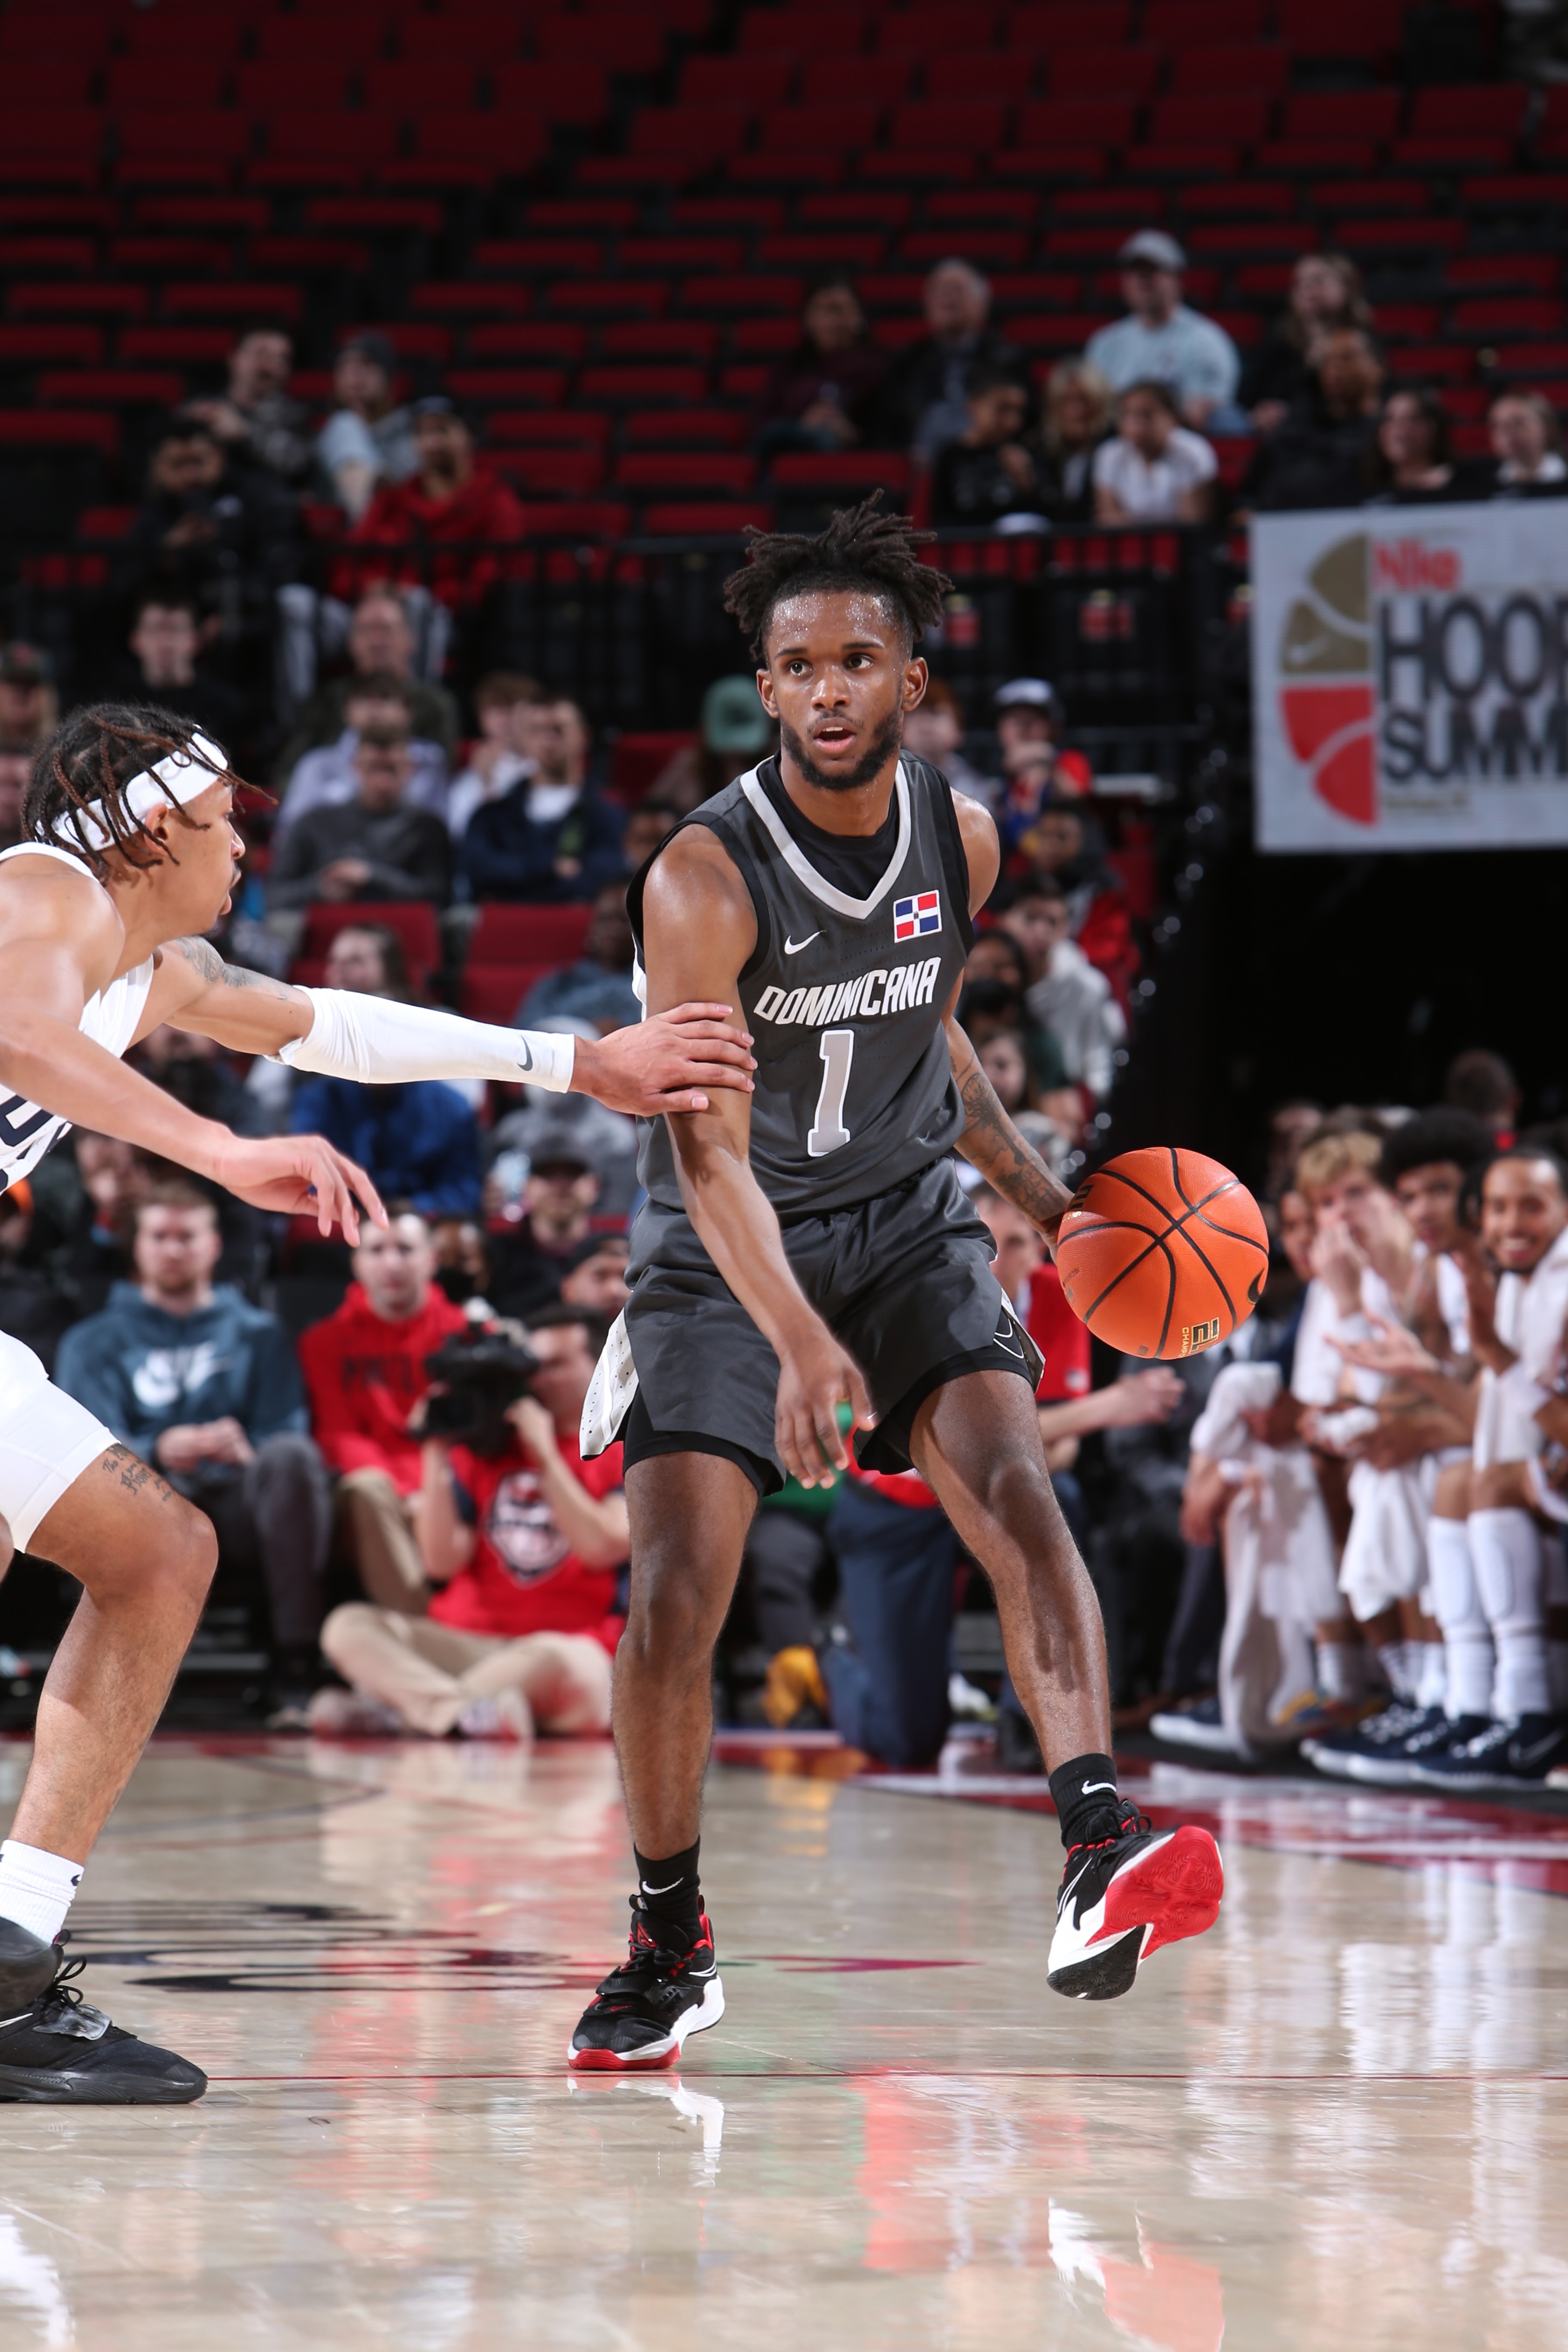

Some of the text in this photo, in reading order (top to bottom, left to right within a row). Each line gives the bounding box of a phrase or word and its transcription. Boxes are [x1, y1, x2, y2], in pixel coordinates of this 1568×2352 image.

[1381, 595, 1568, 702] HOO
[753, 957, 941, 1026] DOMINICANA
[808, 1029, 854, 1157] 1
